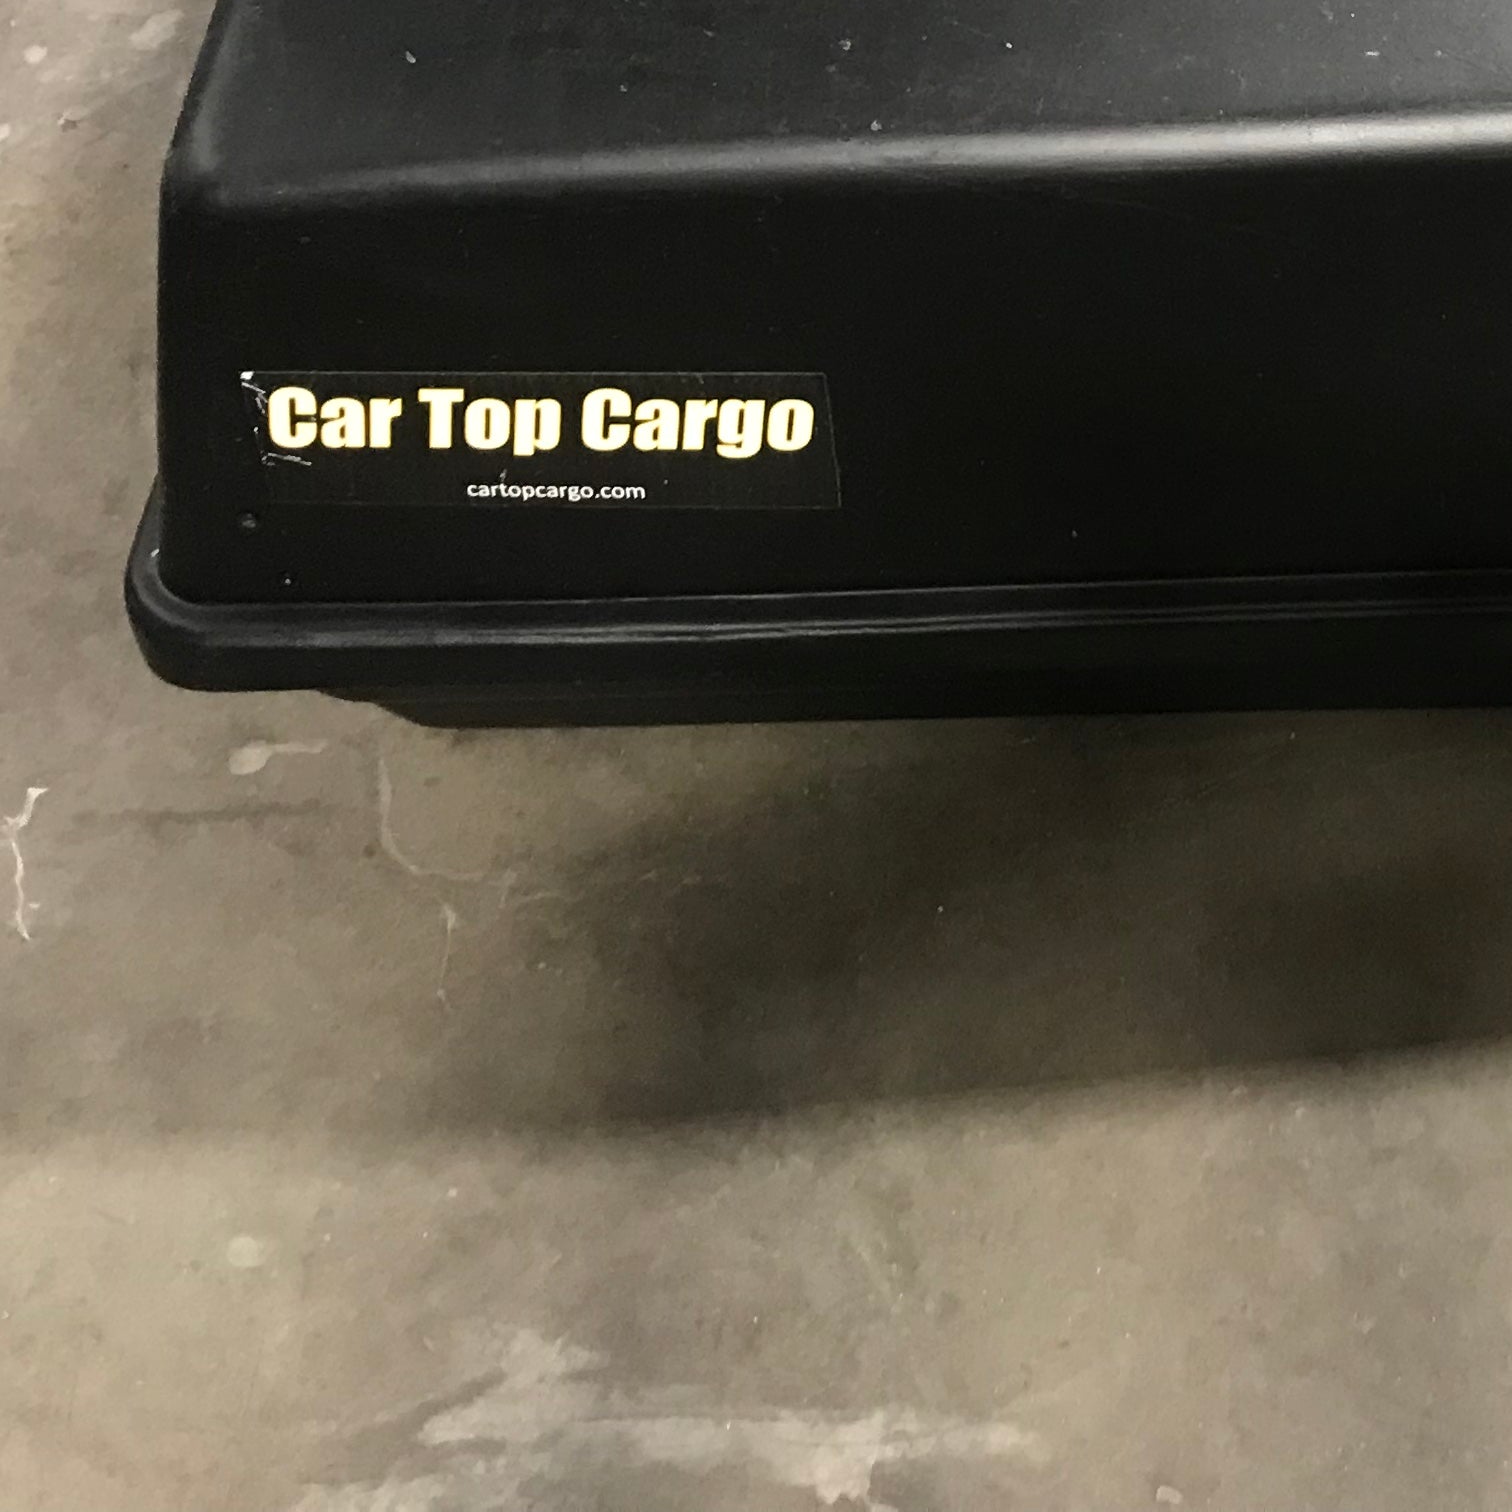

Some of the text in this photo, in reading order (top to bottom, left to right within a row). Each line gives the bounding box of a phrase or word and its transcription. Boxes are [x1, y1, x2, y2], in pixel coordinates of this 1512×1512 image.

[267, 386, 815, 459] Car Top Cargo
[467, 480, 646, 502] cartopcargo.com
